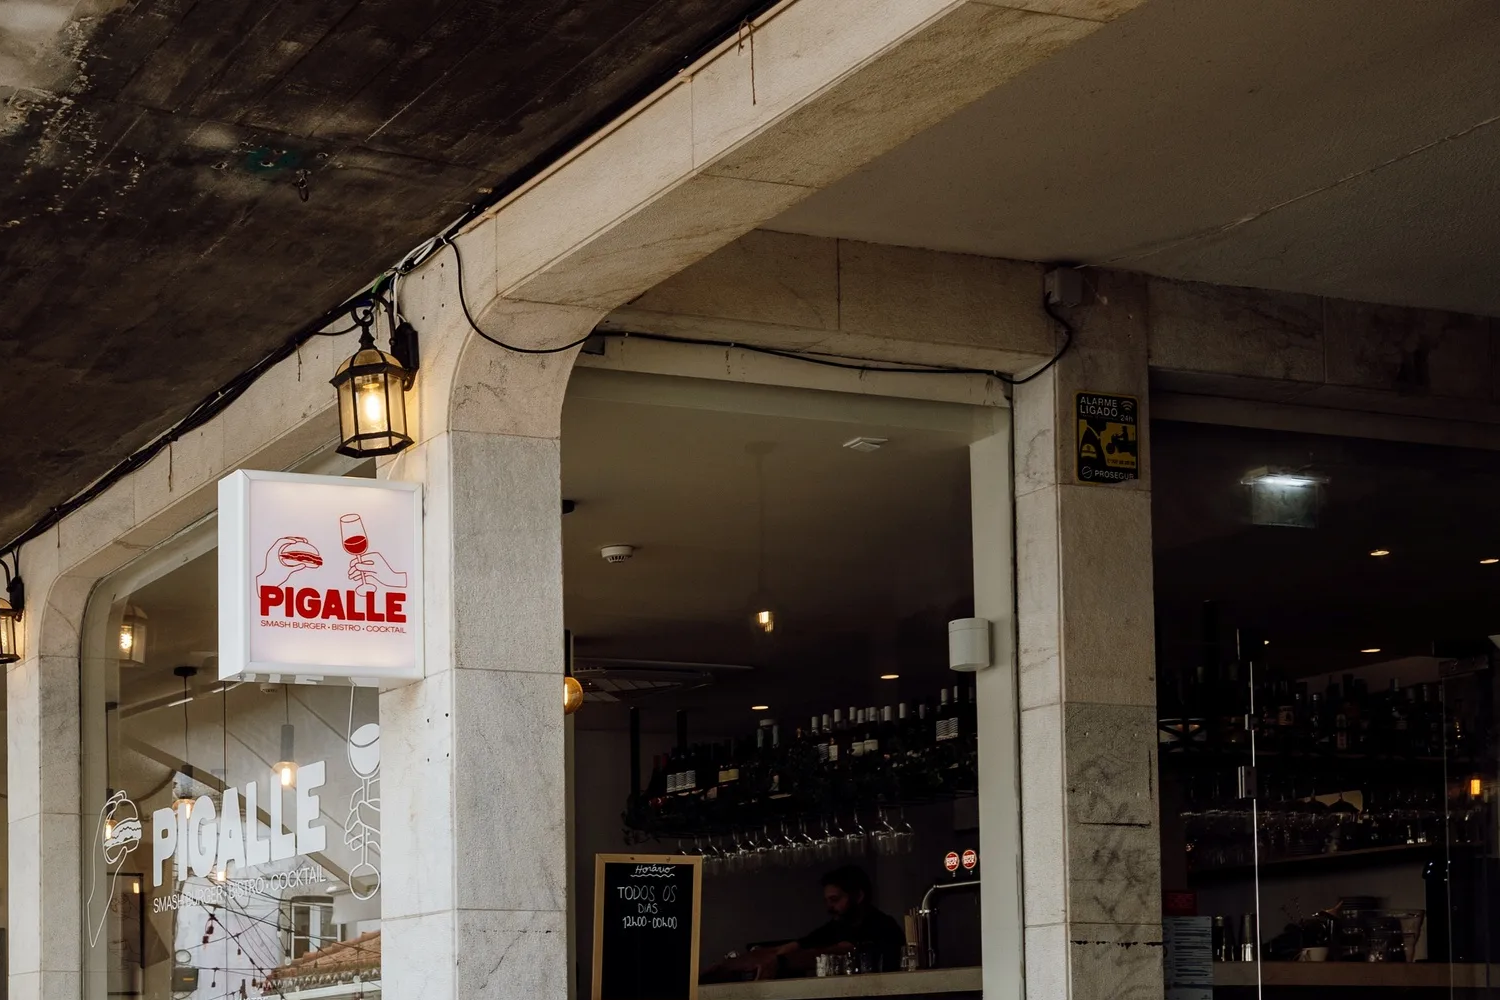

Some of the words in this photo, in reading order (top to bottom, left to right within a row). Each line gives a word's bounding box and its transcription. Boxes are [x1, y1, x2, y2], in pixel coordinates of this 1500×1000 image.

[1080, 397, 1118, 407] ALARME
[1080, 405, 1118, 417] LIGADO
[1095, 470, 1134, 480] PROSEGUR
[260, 585, 406, 623] PIGALLE
[260, 620, 291, 628] SMASH
[293, 622, 326, 630] BURGER
[332, 623, 361, 631] BISTRO
[366, 625, 406, 634] COCKTAIL
[153, 761, 326, 887] PIGALLE
[635, 864, 676, 873] Horário
[153, 895, 185, 913] SMASH
[184, 883, 223, 908] BURGER
[229, 877, 265, 899] BISTRO
[270, 865, 327, 890] COCKTAIL
[617, 885, 655, 902] TODOS
[663, 885, 677, 902] OS
